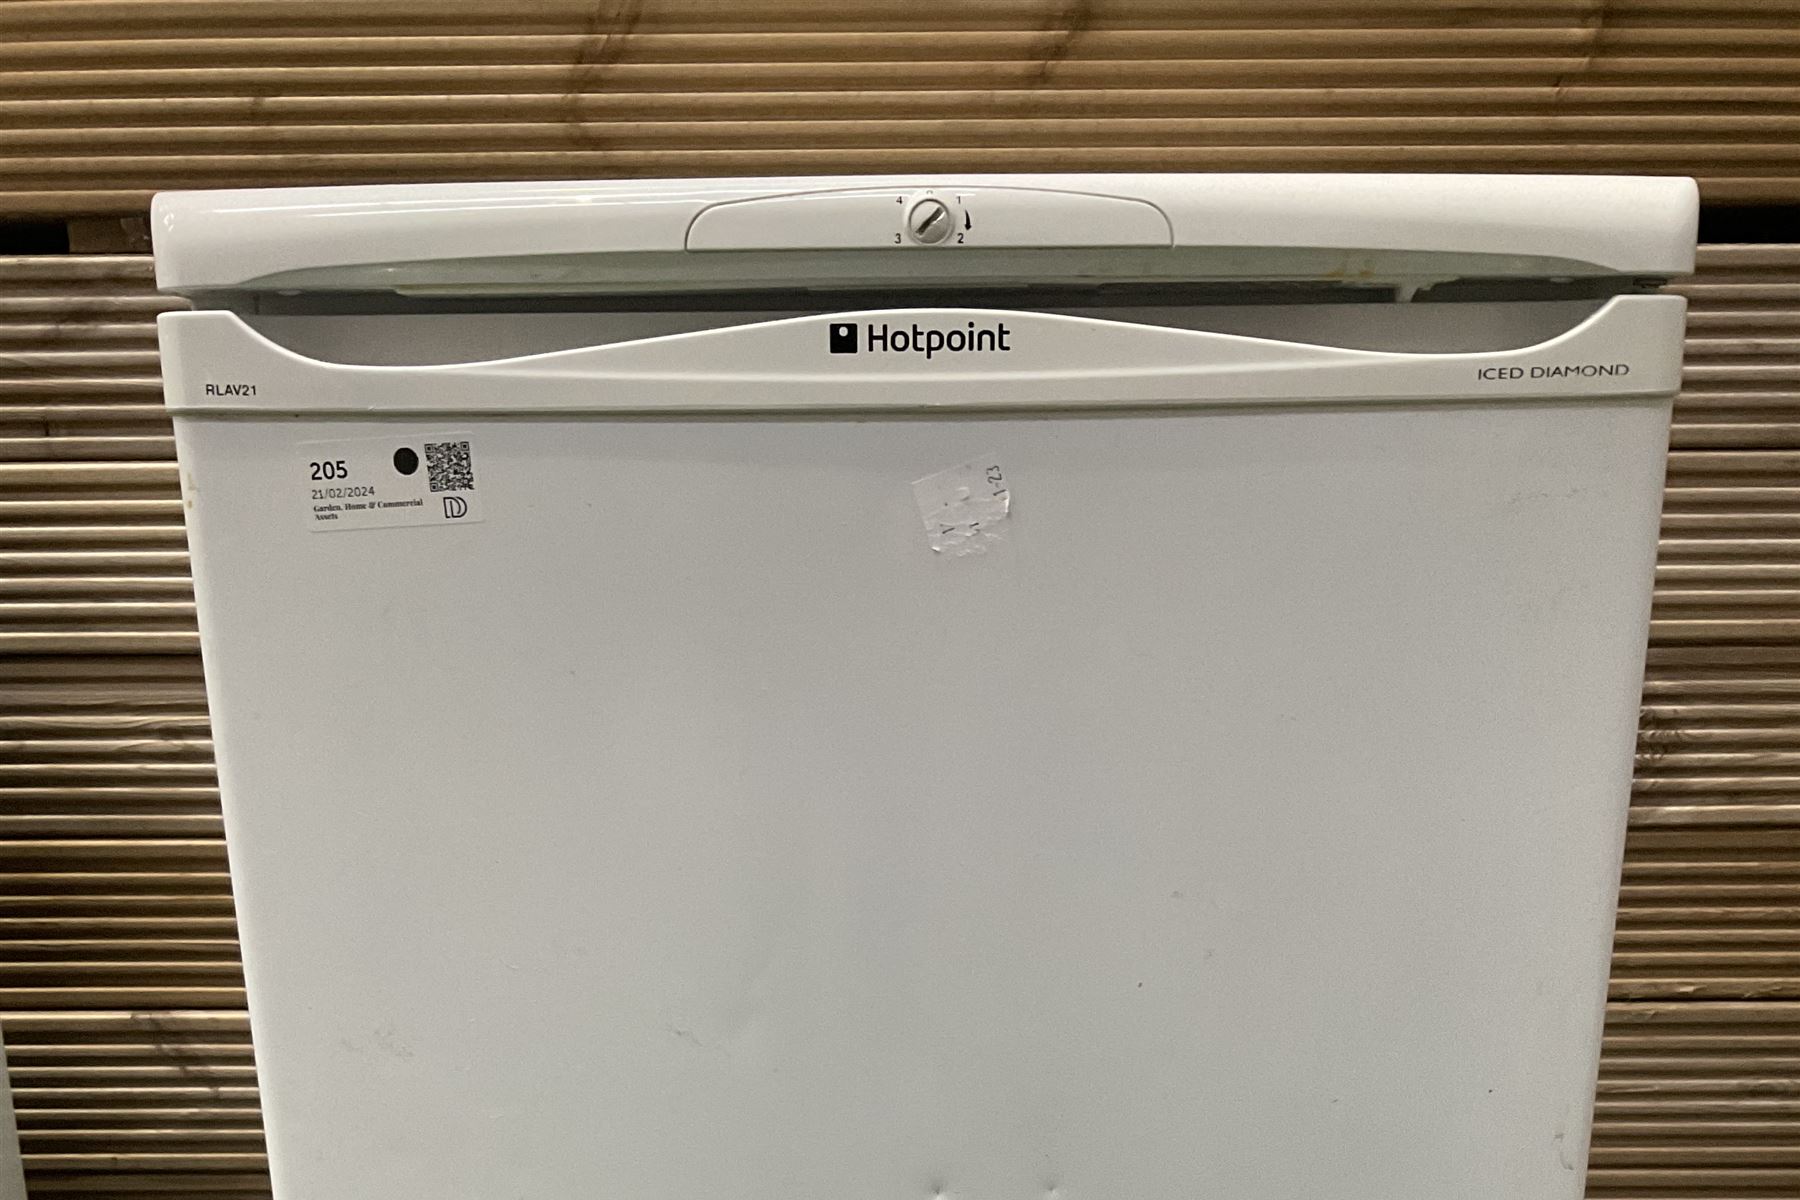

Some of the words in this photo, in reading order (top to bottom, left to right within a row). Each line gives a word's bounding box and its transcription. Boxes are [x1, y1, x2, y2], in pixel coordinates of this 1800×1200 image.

[895, 196, 903, 205] 4
[956, 196, 961, 204] 1
[894, 233, 902, 244] 3
[957, 233, 964, 244] 2
[868, 321, 1011, 360] Hotpoint
[1478, 367, 1524, 381] ICED
[1530, 364, 1630, 379] DIAMOND
[205, 383, 257, 397] RLAV21
[309, 460, 349, 481] 205
[311, 486, 376, 500] 21/02/2024
[345, 500, 367, 511] Home
[377, 498, 424, 509] Commercial
[314, 513, 339, 522] Assets
